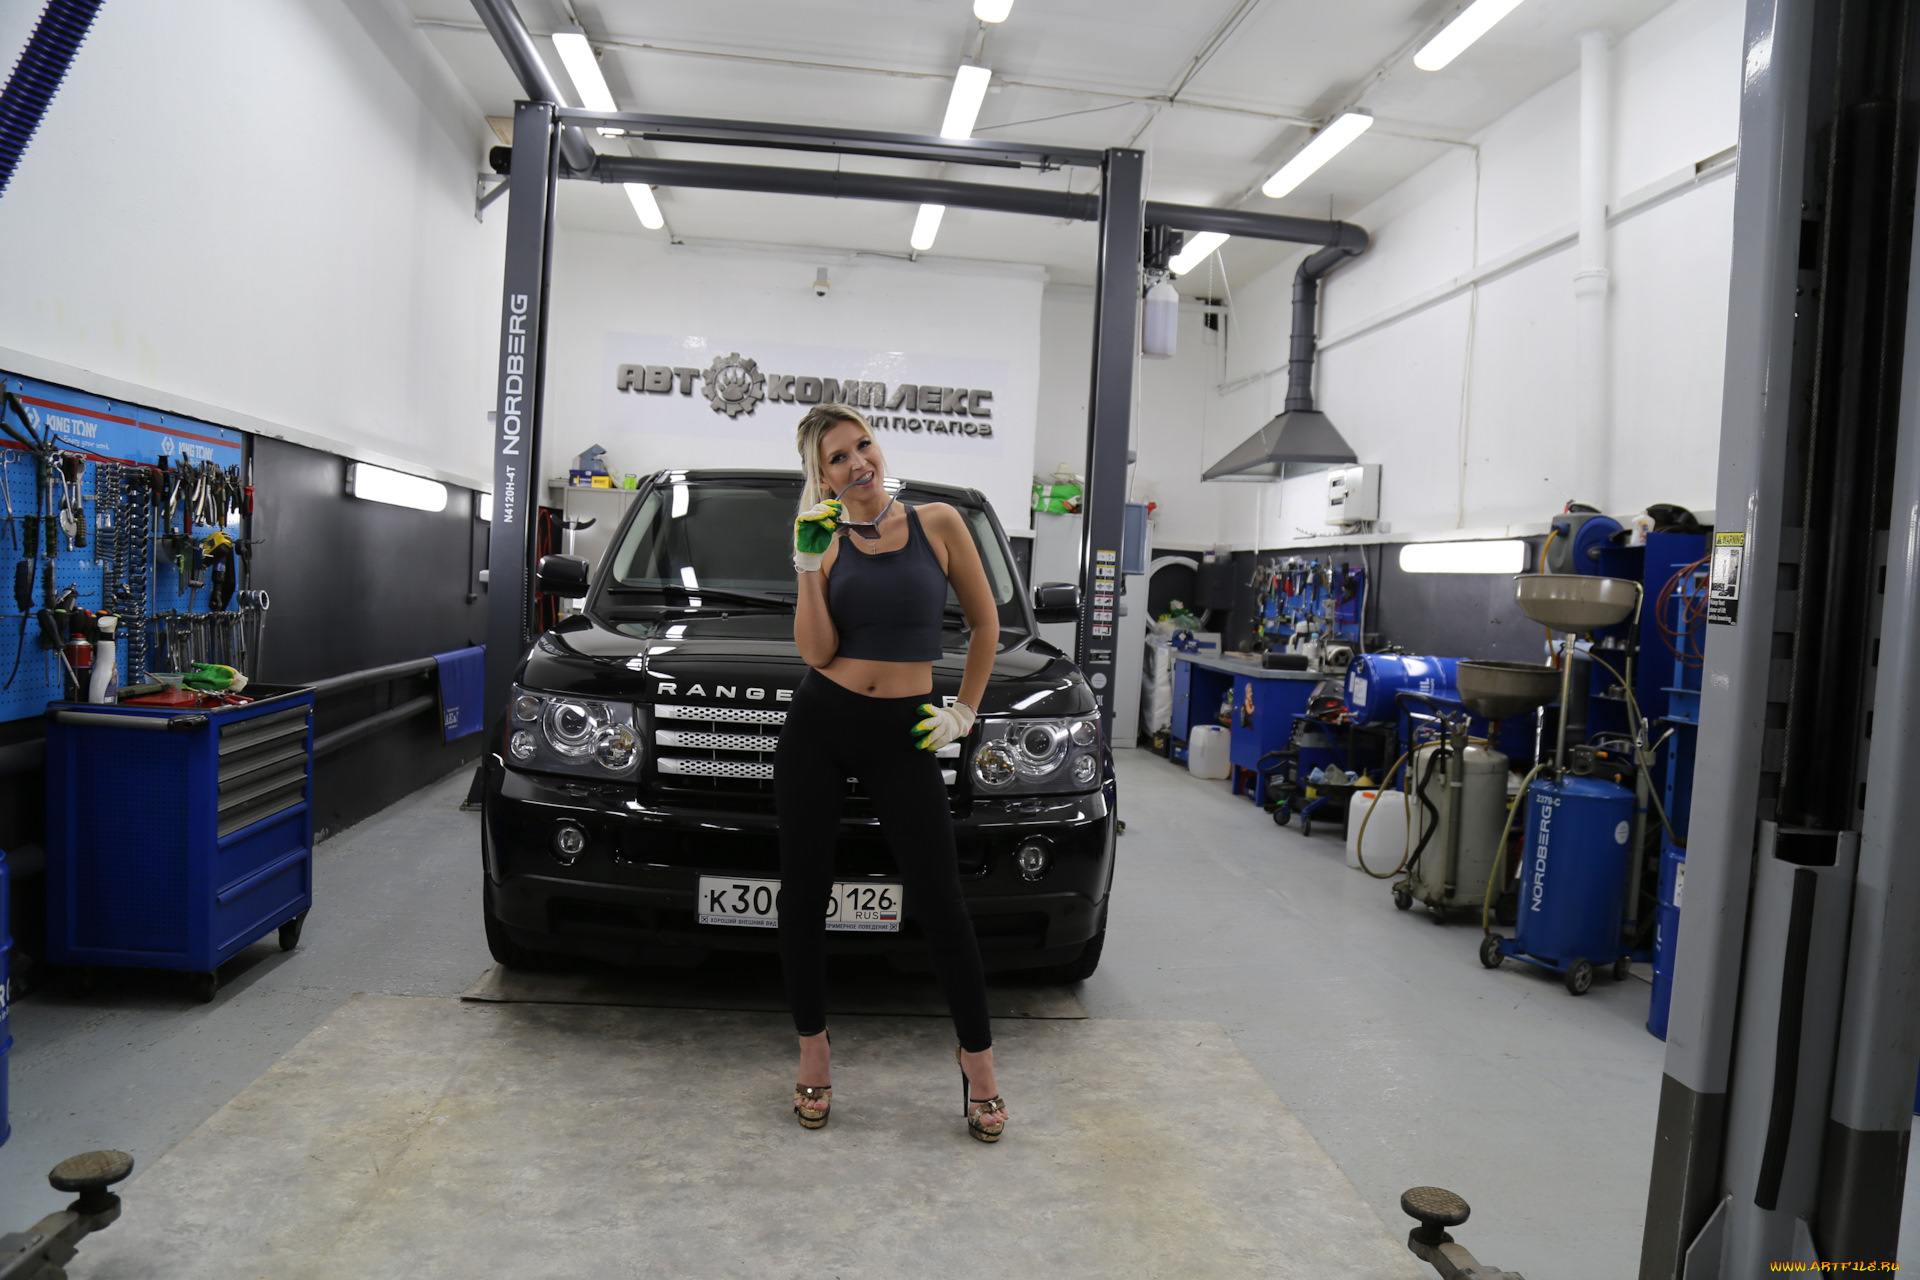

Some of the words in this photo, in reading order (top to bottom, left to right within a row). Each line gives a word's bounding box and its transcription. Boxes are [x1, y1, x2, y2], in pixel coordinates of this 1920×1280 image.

[503, 294, 528, 455] NORDBERG
[768, 373, 993, 418] КОМПЛЕКС
[46, 414, 71, 434] KING
[71, 419, 98, 439] TONY
[892, 416, 993, 438] ПОТАПОВ
[504, 465, 516, 523] N4120H-4T
[1723, 535, 1744, 545] WARNING
[657, 682, 794, 701] RANGE
[1536, 794, 1561, 807] 2379-C
[1531, 805, 1552, 912] NORDBERG
[846, 888, 893, 911] 126
[855, 911, 879, 920] RUS
